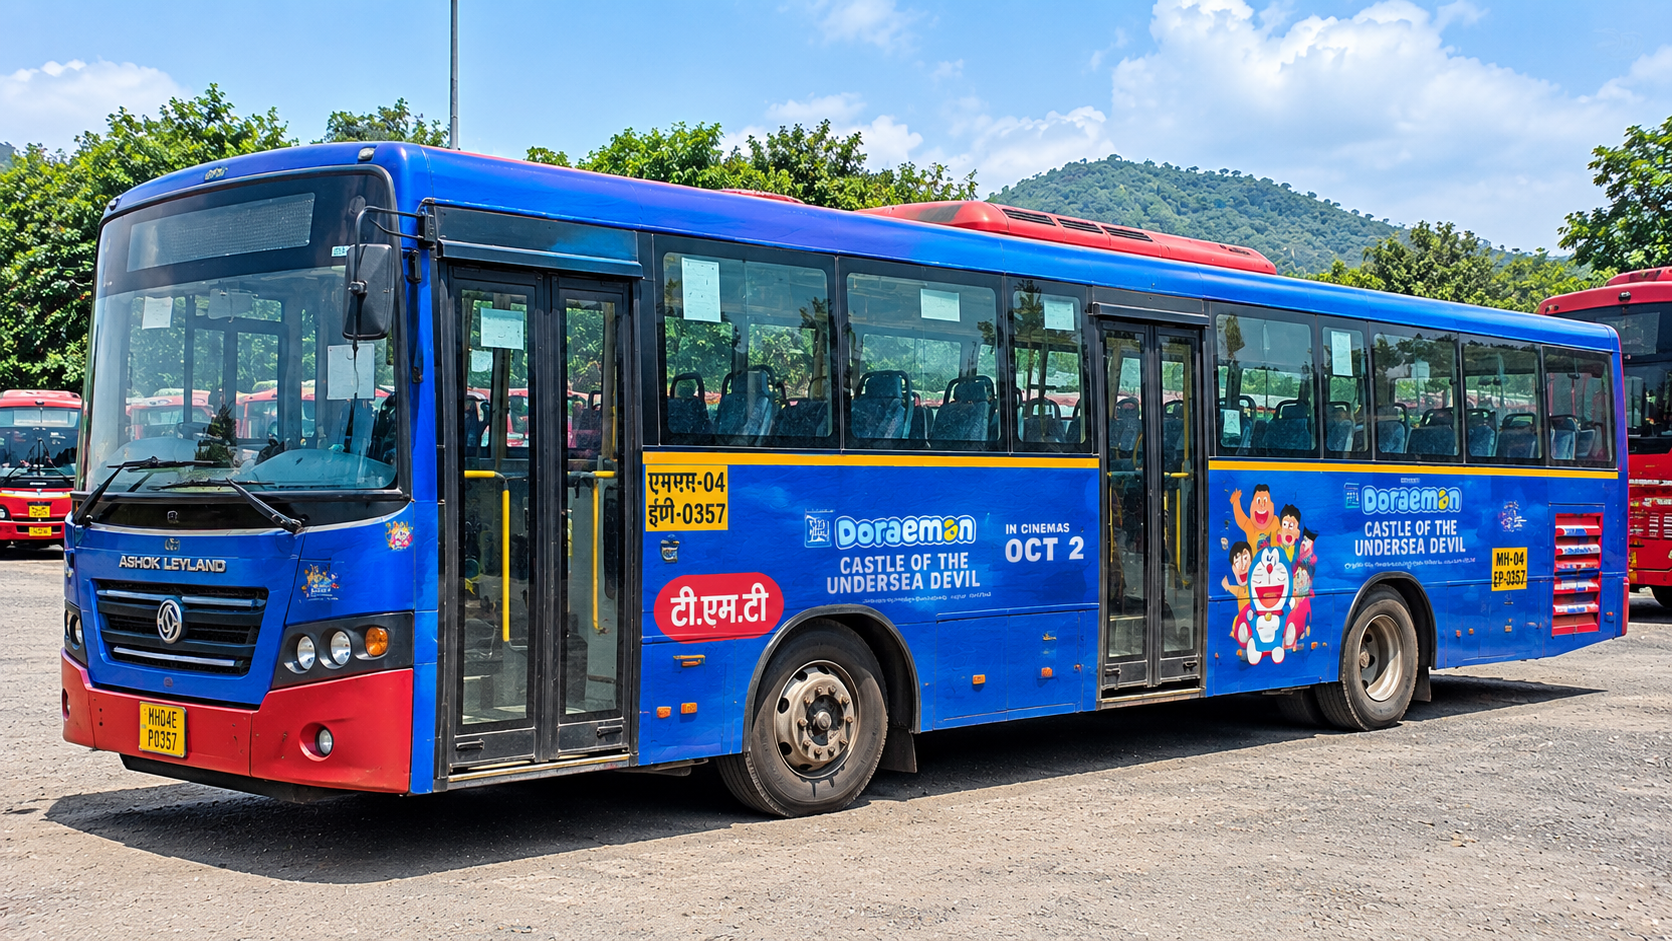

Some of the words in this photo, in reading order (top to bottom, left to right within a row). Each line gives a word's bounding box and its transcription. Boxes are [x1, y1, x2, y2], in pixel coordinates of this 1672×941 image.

[1362, 485, 1462, 515] Doraemon
[835, 515, 976, 550] Doraemon
[1005, 523, 1017, 535] IN
[1021, 522, 1070, 534] CINEMAS
[1364, 521, 1412, 537] CASTLE
[1415, 520, 1432, 536] OF
[1435, 520, 1457, 535] THE
[1005, 537, 1059, 563] OCT
[1068, 536, 1084, 560] 2
[1354, 537, 1425, 557] UNDERSEA
[1430, 536, 1466, 554] DEVIL
[118, 554, 161, 570] ASHOK
[163, 556, 227, 573] LEYLAND
[840, 554, 905, 574] CASTLE
[911, 553, 931, 571] OF
[937, 551, 969, 570] THE
[827, 572, 924, 595] UNDERSEA
[930, 569, 981, 590] DEVIL
